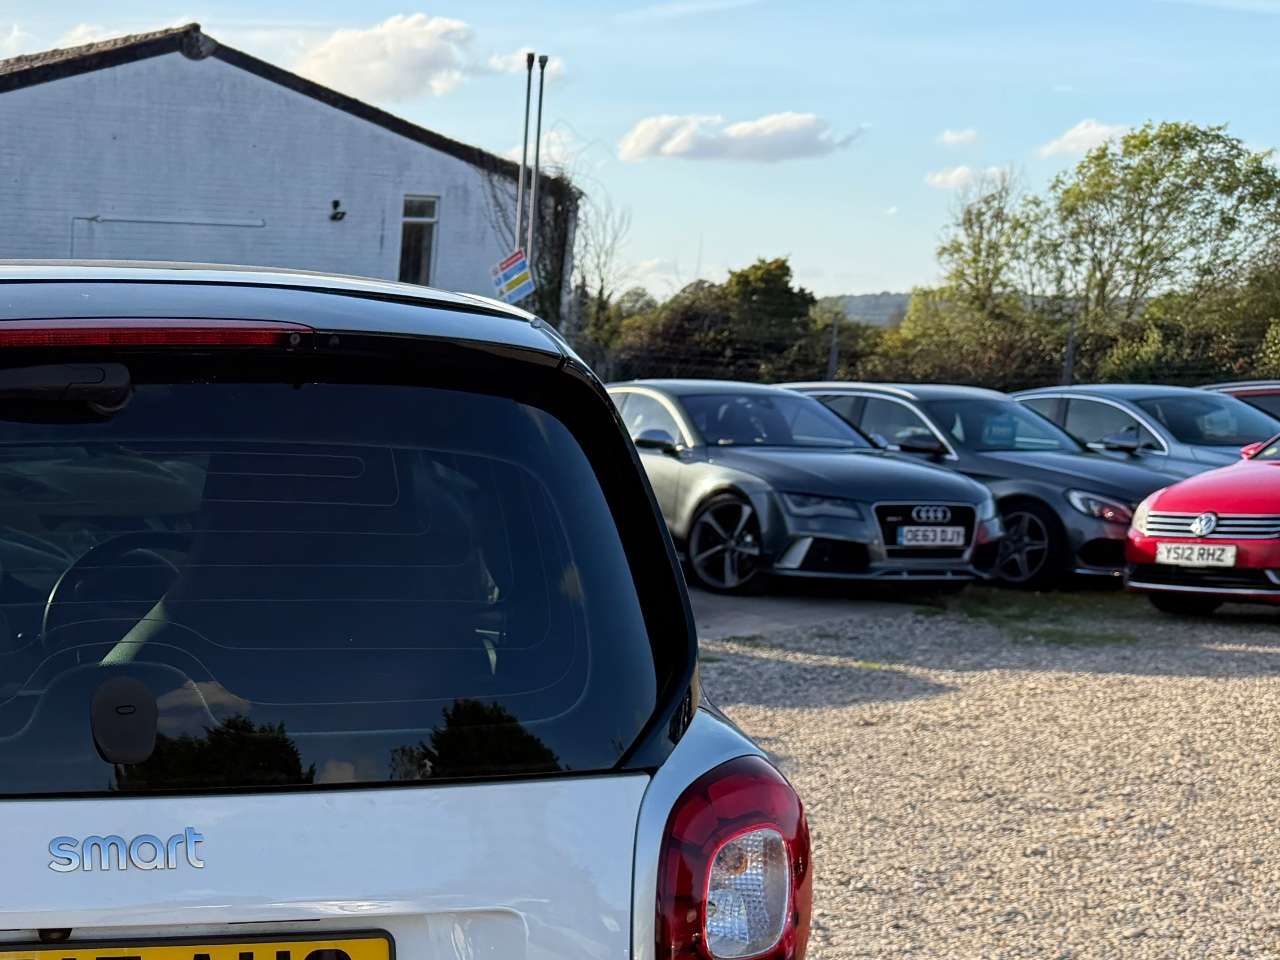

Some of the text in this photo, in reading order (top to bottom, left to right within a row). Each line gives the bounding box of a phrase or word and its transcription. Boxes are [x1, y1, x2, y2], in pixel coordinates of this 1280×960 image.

[1165, 545, 1226, 563] YS12 RHZ
[48, 826, 206, 873] smart
